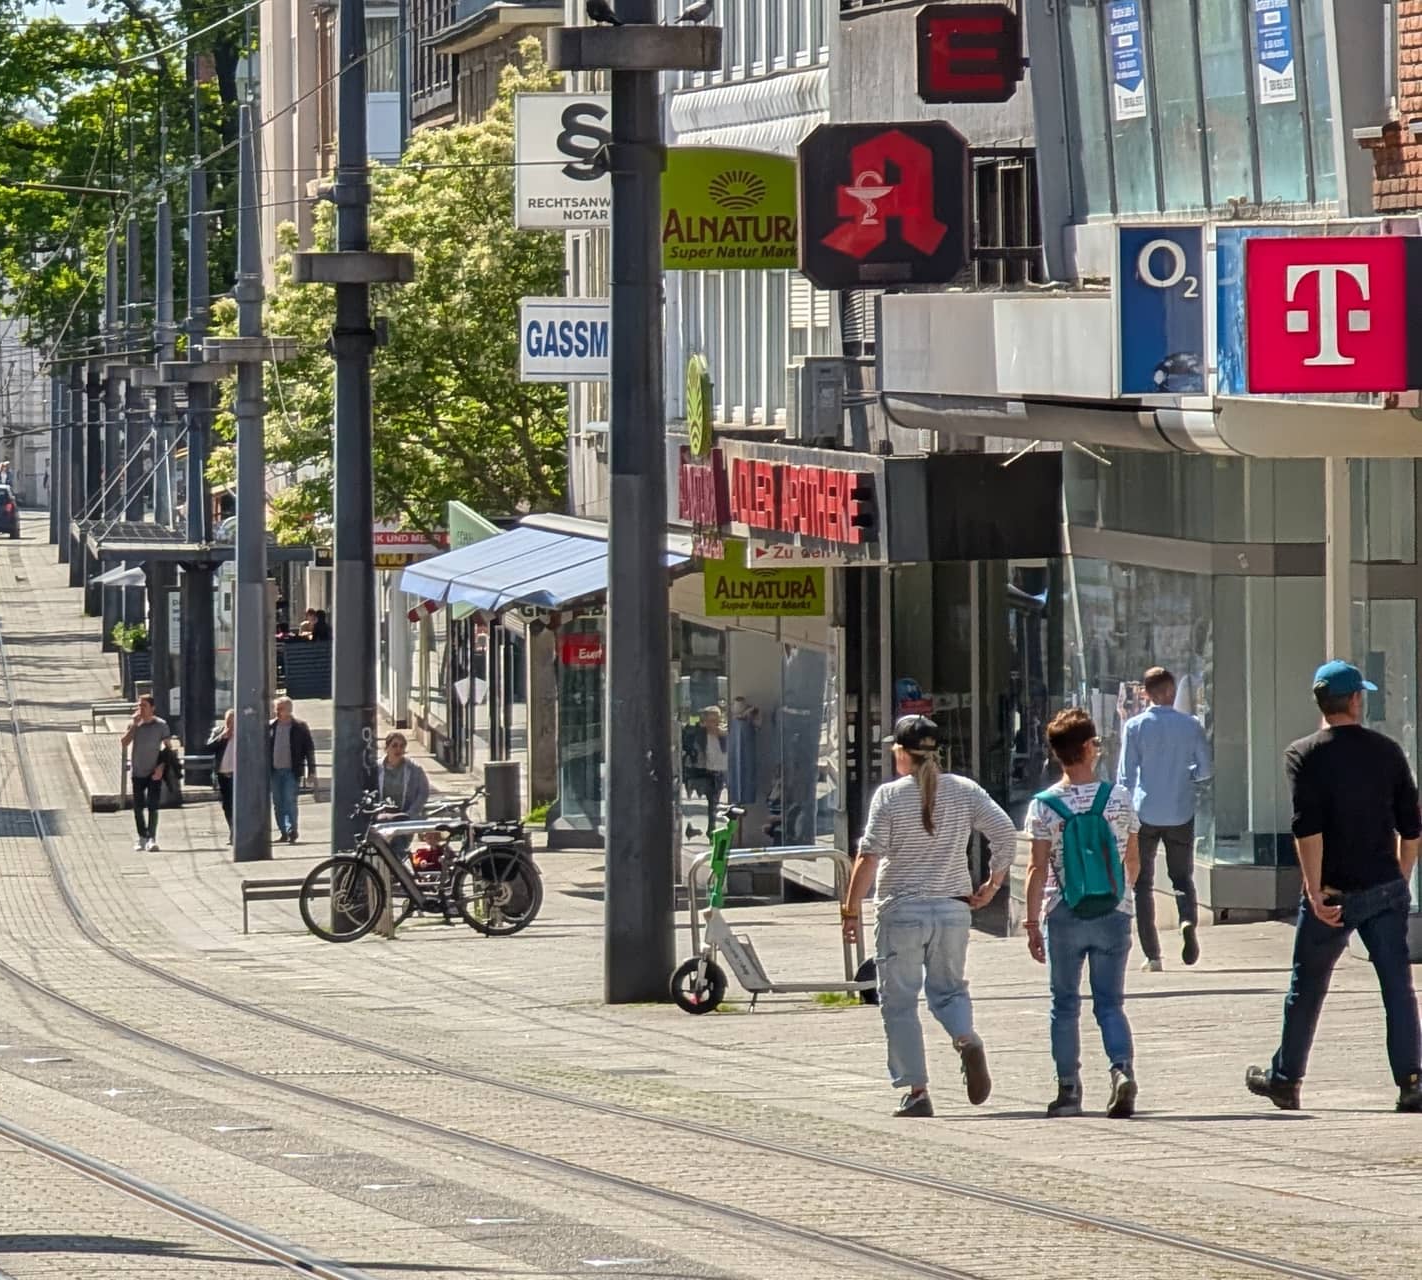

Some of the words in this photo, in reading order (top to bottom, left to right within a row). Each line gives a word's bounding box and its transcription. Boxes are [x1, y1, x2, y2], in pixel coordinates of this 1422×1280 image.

[930, 17, 1002, 91] E
[528, 198, 610, 208] RECHTSANW
[662, 208, 797, 243] ALNATUR
[670, 245, 714, 260] Super
[716, 245, 758, 258] Natur
[761, 245, 797, 258] Mark
[1286, 263, 1370, 366] T
[527, 320, 609, 357] GASSM
[731, 458, 775, 529] ADLER
[781, 464, 861, 544] APOTHEKE
[386, 534, 408, 543] UND
[773, 546, 793, 559] Zu
[714, 575, 817, 599] ALNATURA
